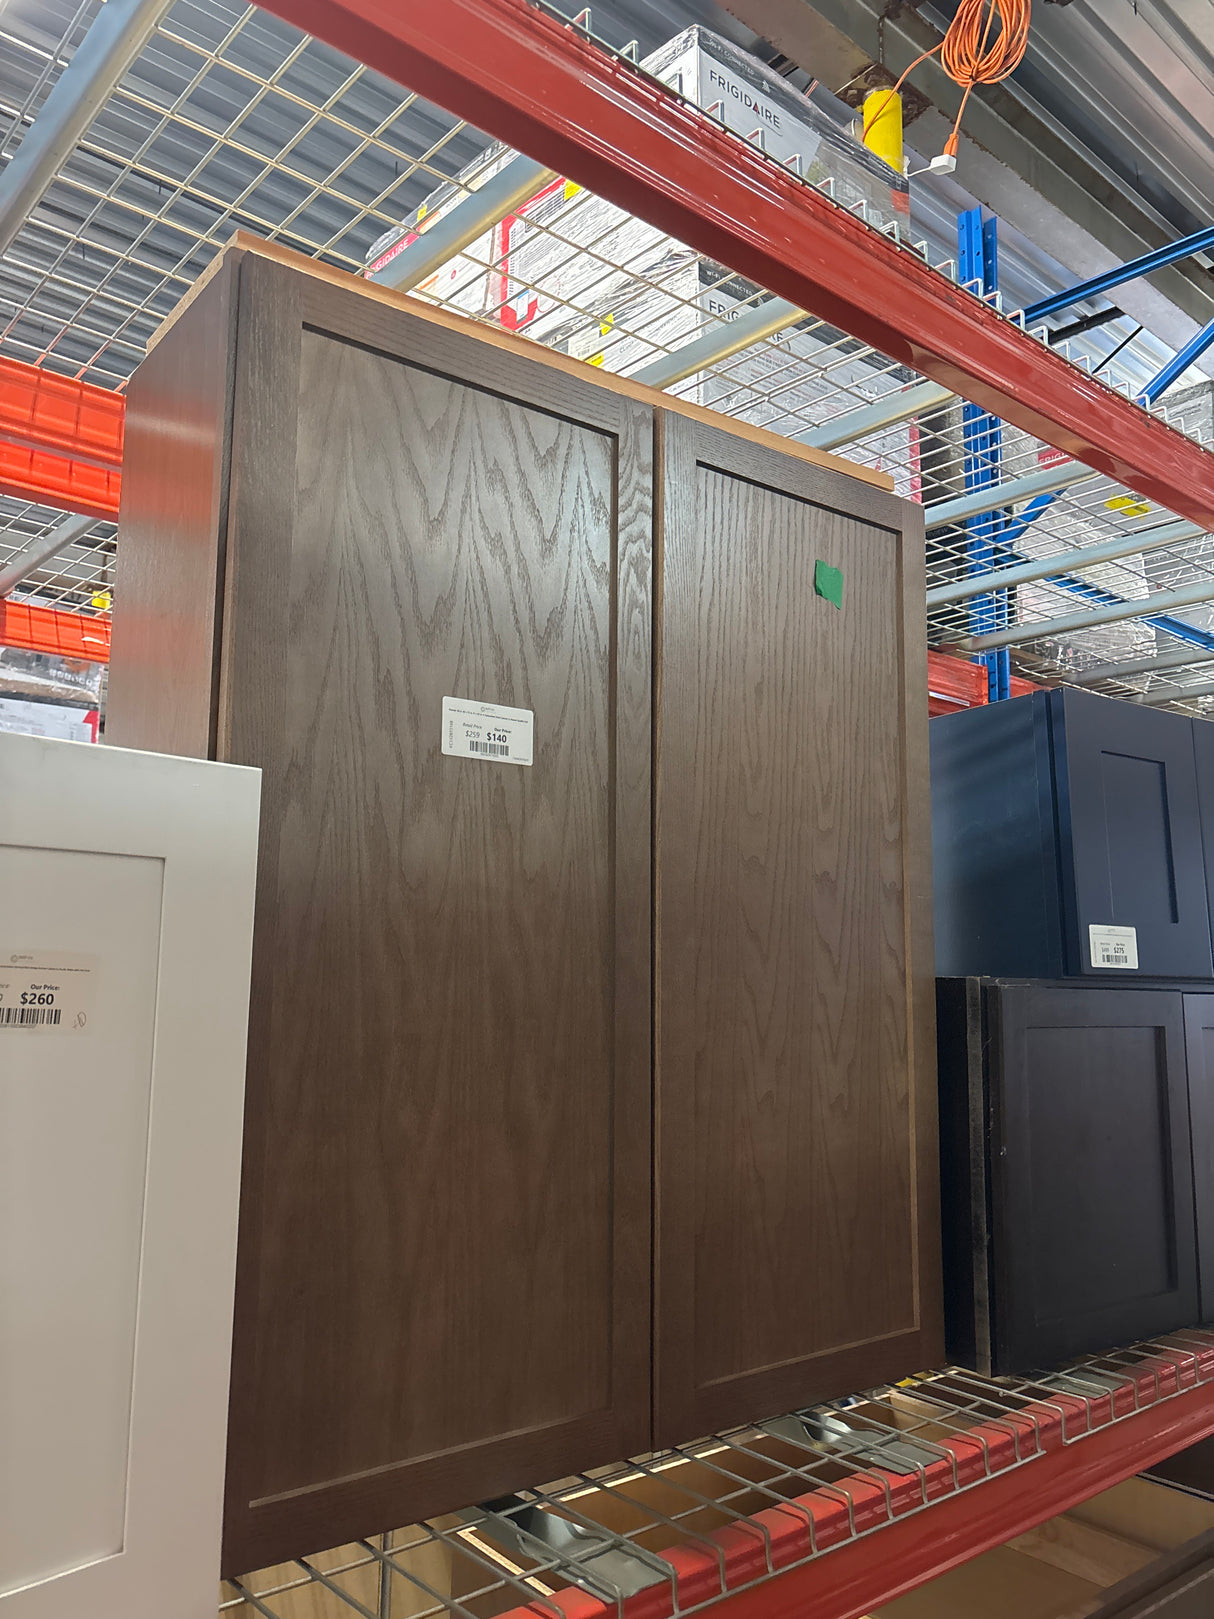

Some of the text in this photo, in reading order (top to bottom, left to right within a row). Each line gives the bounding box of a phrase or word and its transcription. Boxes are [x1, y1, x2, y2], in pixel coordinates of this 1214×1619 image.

[709, 69, 781, 128] FRIGIDAIRE
[465, 730, 481, 739] $259
[486, 732, 507, 743] $140
[1113, 946, 1125, 954] $275
[20, 991, 55, 1006] $260
